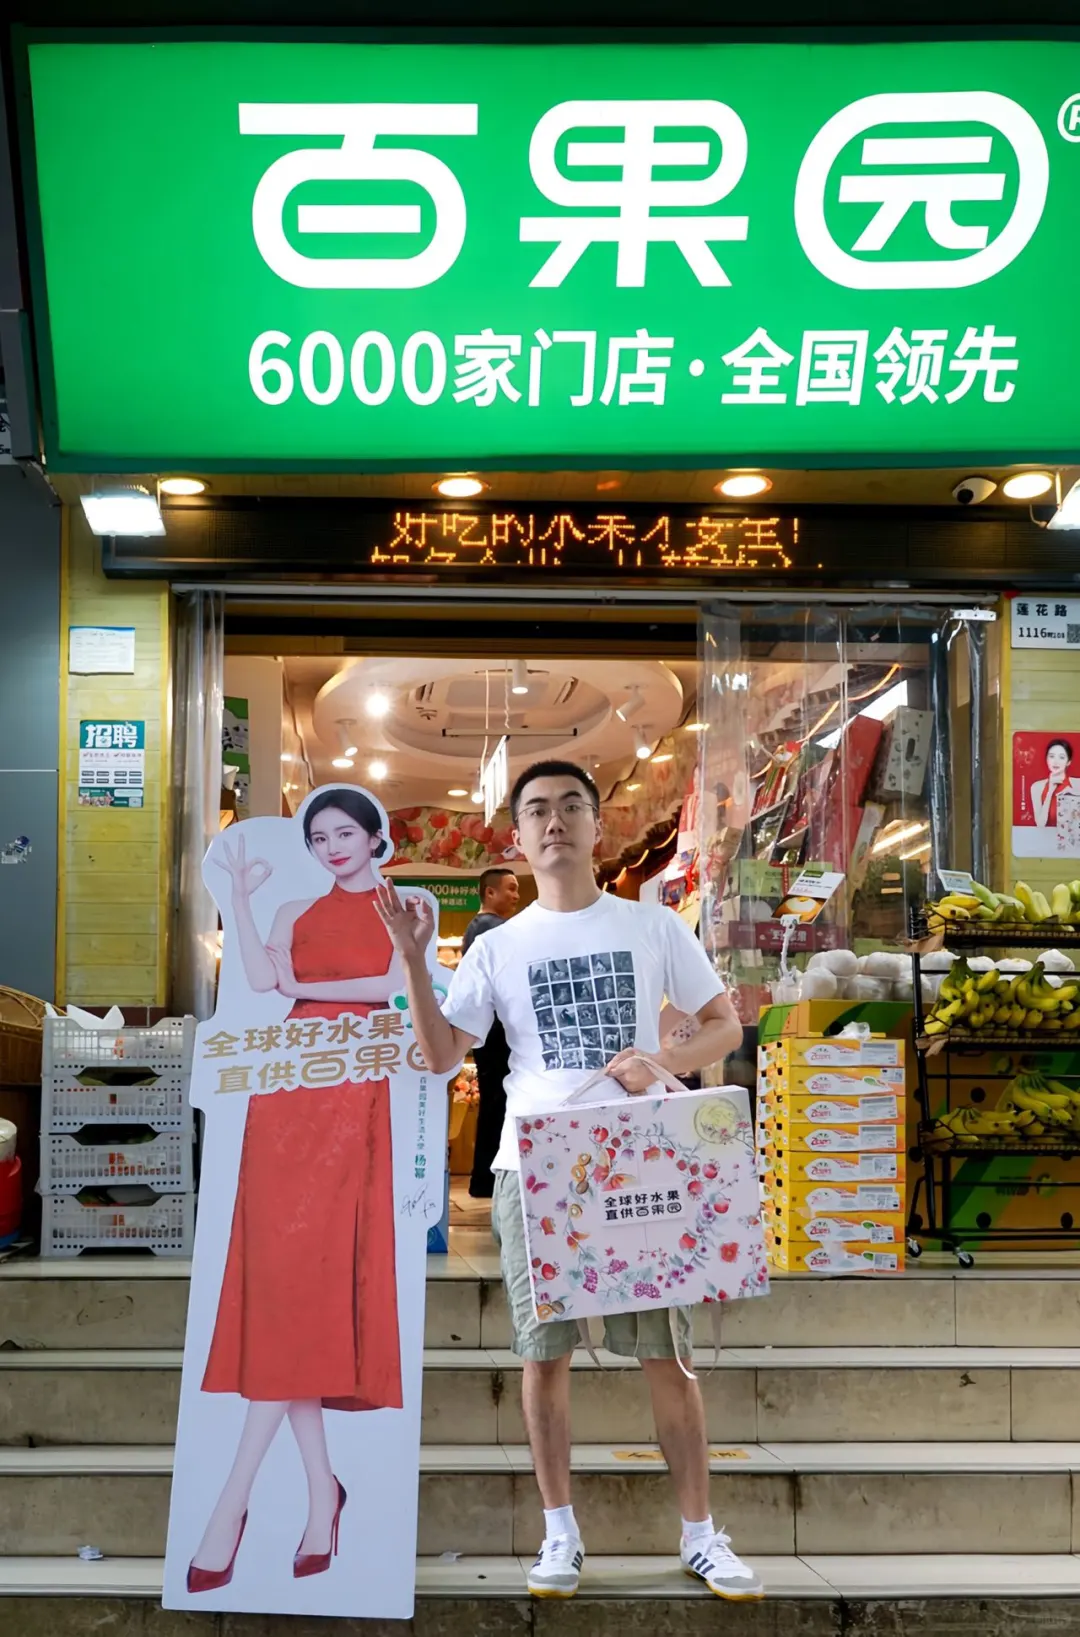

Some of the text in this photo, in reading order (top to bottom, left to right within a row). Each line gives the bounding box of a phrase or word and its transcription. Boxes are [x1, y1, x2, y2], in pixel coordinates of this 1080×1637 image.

[239, 92, 1049, 289] 百果园
[84, 722, 138, 749] 招聘
[202, 1012, 405, 1059] 全球好水果
[604, 1189, 680, 1209] 全球好水果
[605, 1202, 682, 1221] 直供百果园
